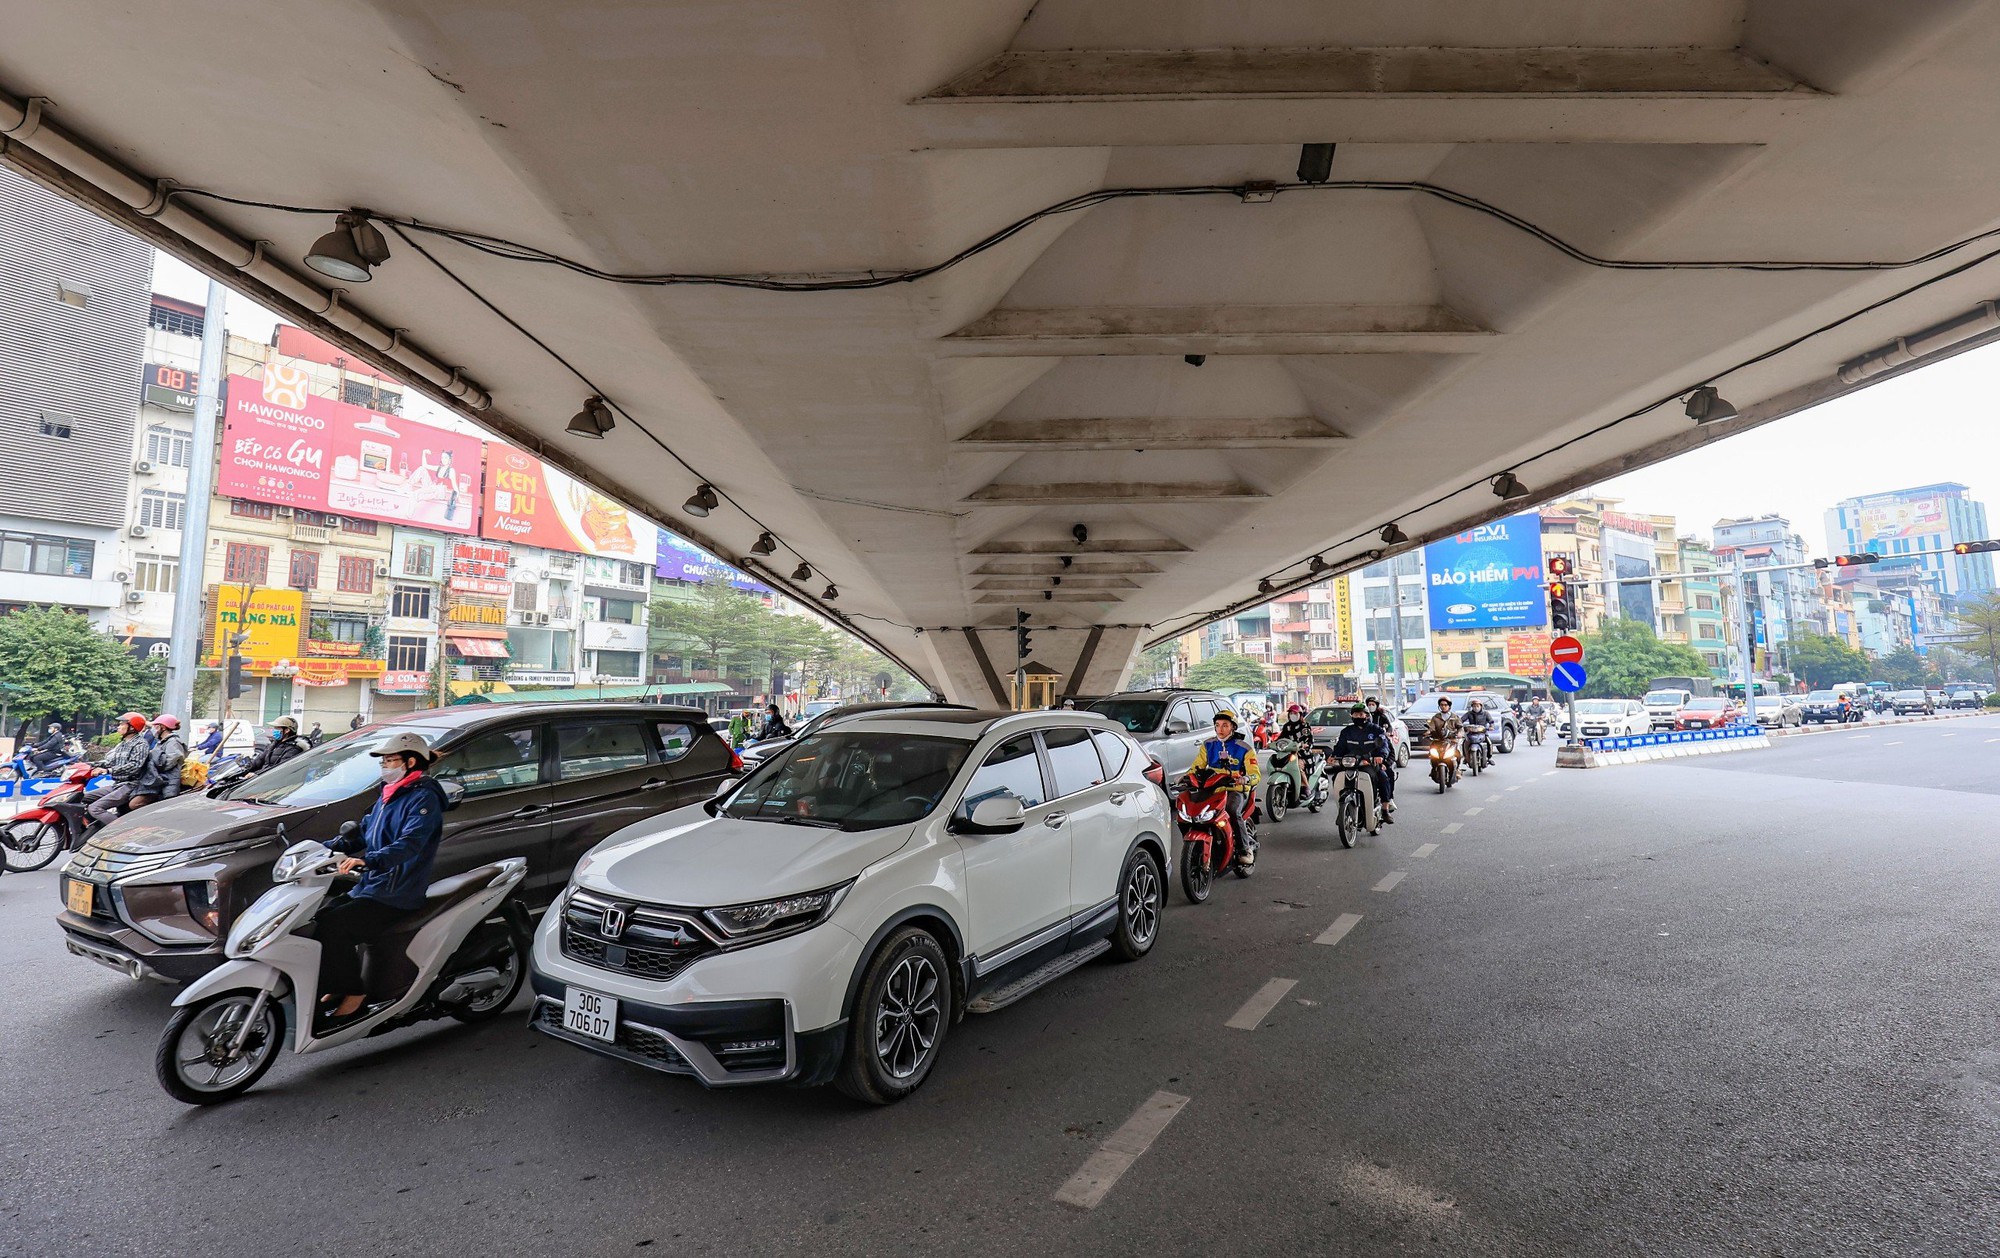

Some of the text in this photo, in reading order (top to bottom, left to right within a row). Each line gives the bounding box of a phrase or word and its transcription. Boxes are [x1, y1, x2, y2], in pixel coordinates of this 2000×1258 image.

[237, 399, 325, 430] HAWONKOO
[234, 457, 320, 480] CHỌN HAWONKOO
[496, 468, 537, 494] KEN
[512, 494, 536, 515] JU
[1473, 524, 1506, 538] PVI
[1474, 534, 1510, 542] INSURANCE
[1431, 562, 1540, 586] BẢO HIỂM PVI
[579, 993, 602, 1015] 30G
[569, 1010, 610, 1037] 706.07
